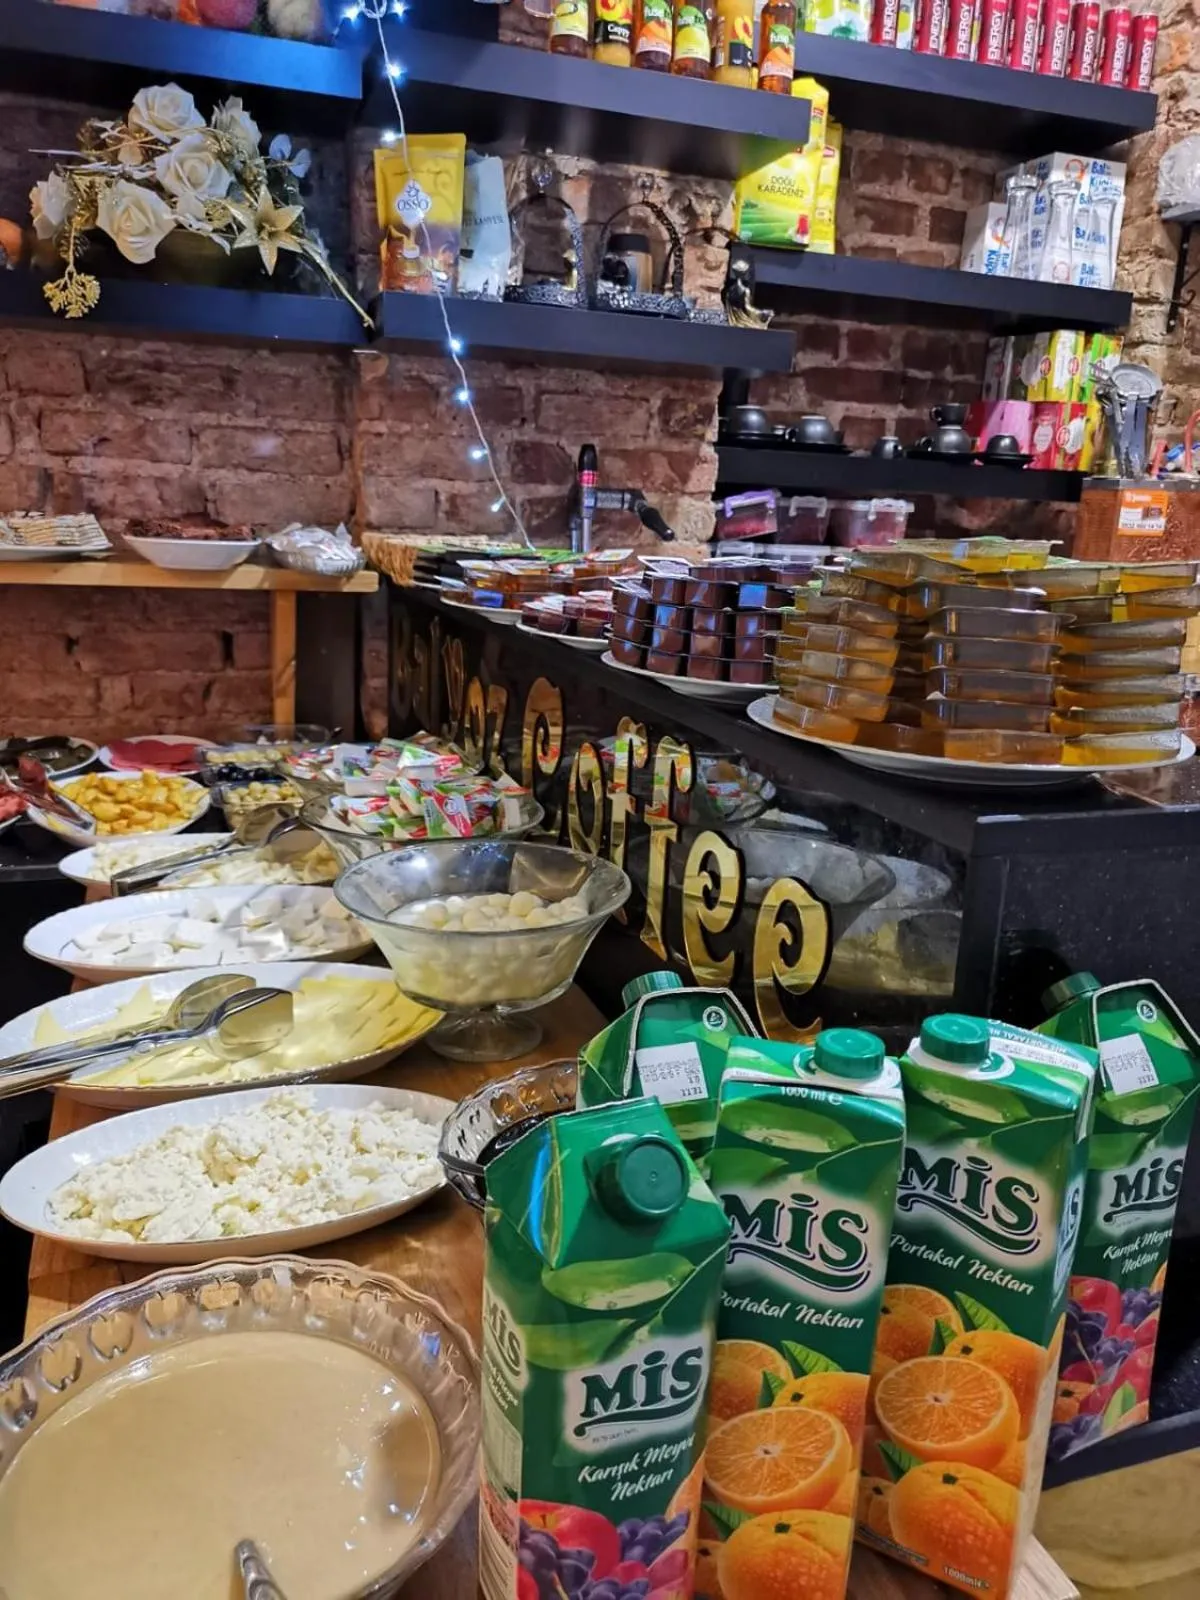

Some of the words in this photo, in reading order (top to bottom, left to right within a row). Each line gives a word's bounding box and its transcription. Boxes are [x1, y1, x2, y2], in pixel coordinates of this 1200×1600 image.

[956, 3, 971, 54] ENERGY
[987, 10, 1005, 60] ENERGY
[1021, 15, 1037, 66] ENERGY
[1050, 20, 1067, 71] ENERGY
[1080, 27, 1097, 76] ENERGY
[1111, 32, 1128, 82] ENERGY
[1138, 39, 1154, 86] ENERGY
[397, 199, 430, 212] OSSO
[889, 1231, 963, 1270] Portakal
[610, 1467, 675, 1502] Nektarı
